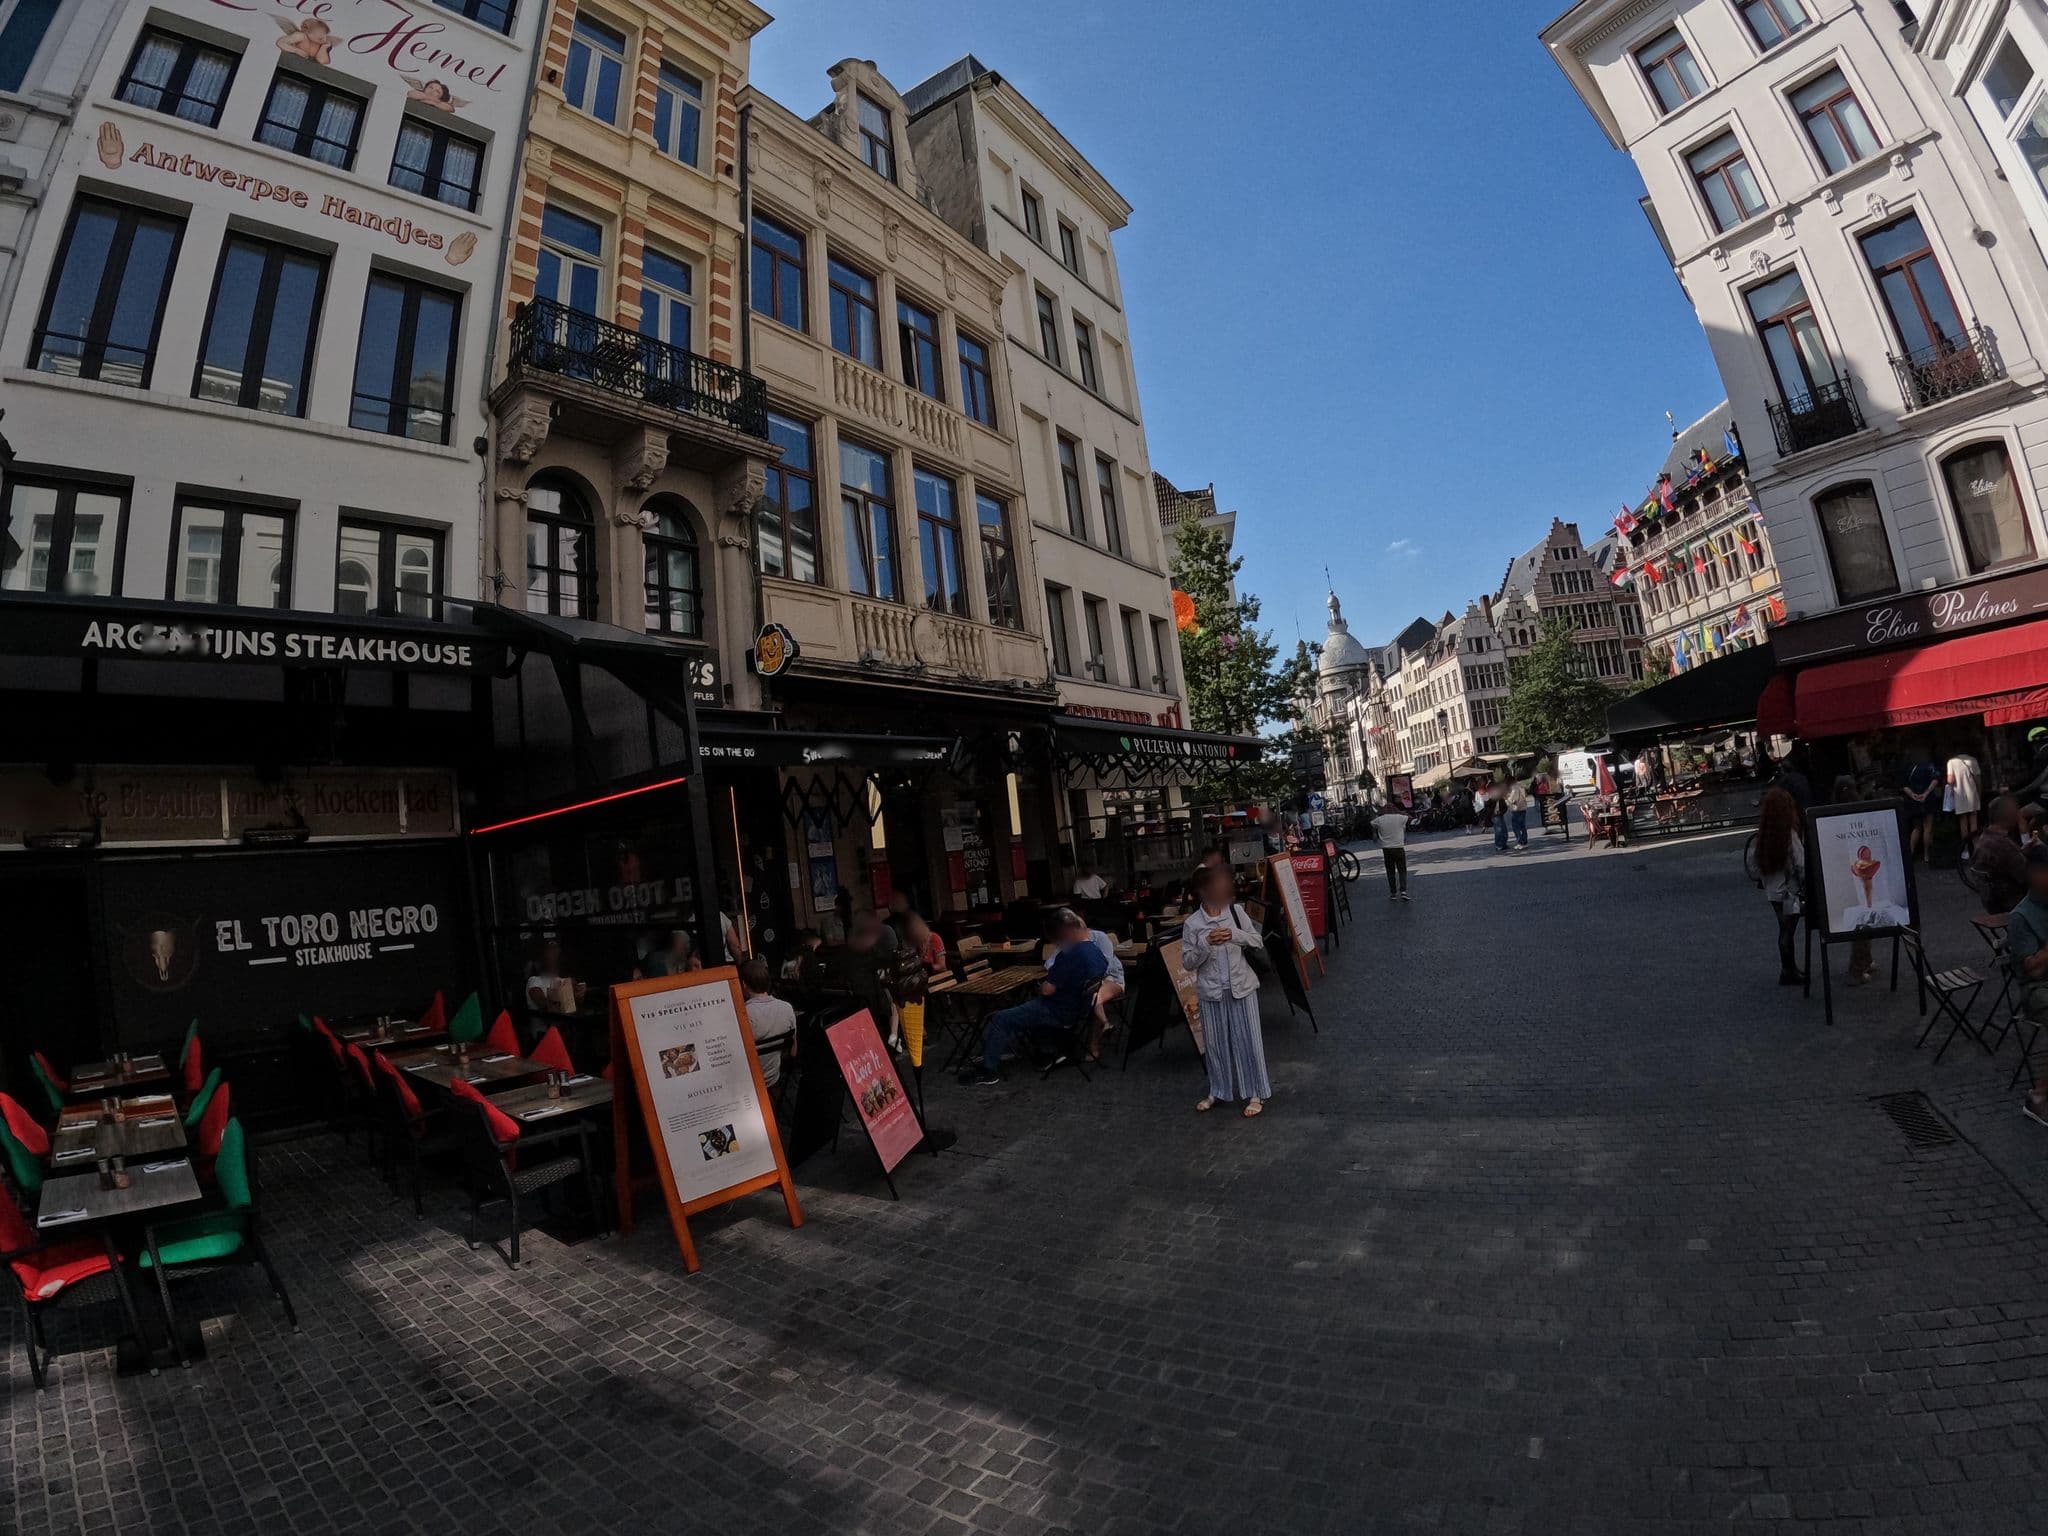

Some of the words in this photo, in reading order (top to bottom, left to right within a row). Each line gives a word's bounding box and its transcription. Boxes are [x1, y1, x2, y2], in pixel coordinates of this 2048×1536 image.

[347, 0, 507, 92] Hemel
[129, 142, 308, 208] Antwerpse
[320, 194, 443, 250] Handjes
[1865, 607, 1920, 644] Elisa
[1928, 590, 2018, 629] Pralines
[285, 633, 472, 667] STEAKHOUSE
[693, 691, 714, 701] FFLES
[699, 746, 711, 757] ES
[712, 747, 725, 757] ON
[726, 747, 743, 757] THE
[1133, 738, 1183, 755] PIZZERIA
[1192, 743, 1228, 758] ANTONIO
[314, 783, 438, 815] Koekentad
[1835, 828, 1880, 841] SIGNATURE
[1849, 820, 1865, 829] THE
[215, 919, 253, 952] EL
[260, 912, 339, 948] TORO
[348, 903, 438, 940] NEGRO
[294, 943, 373, 967] STEAKHOUSE
[658, 998, 726, 1017] SPECIALITEITEN
